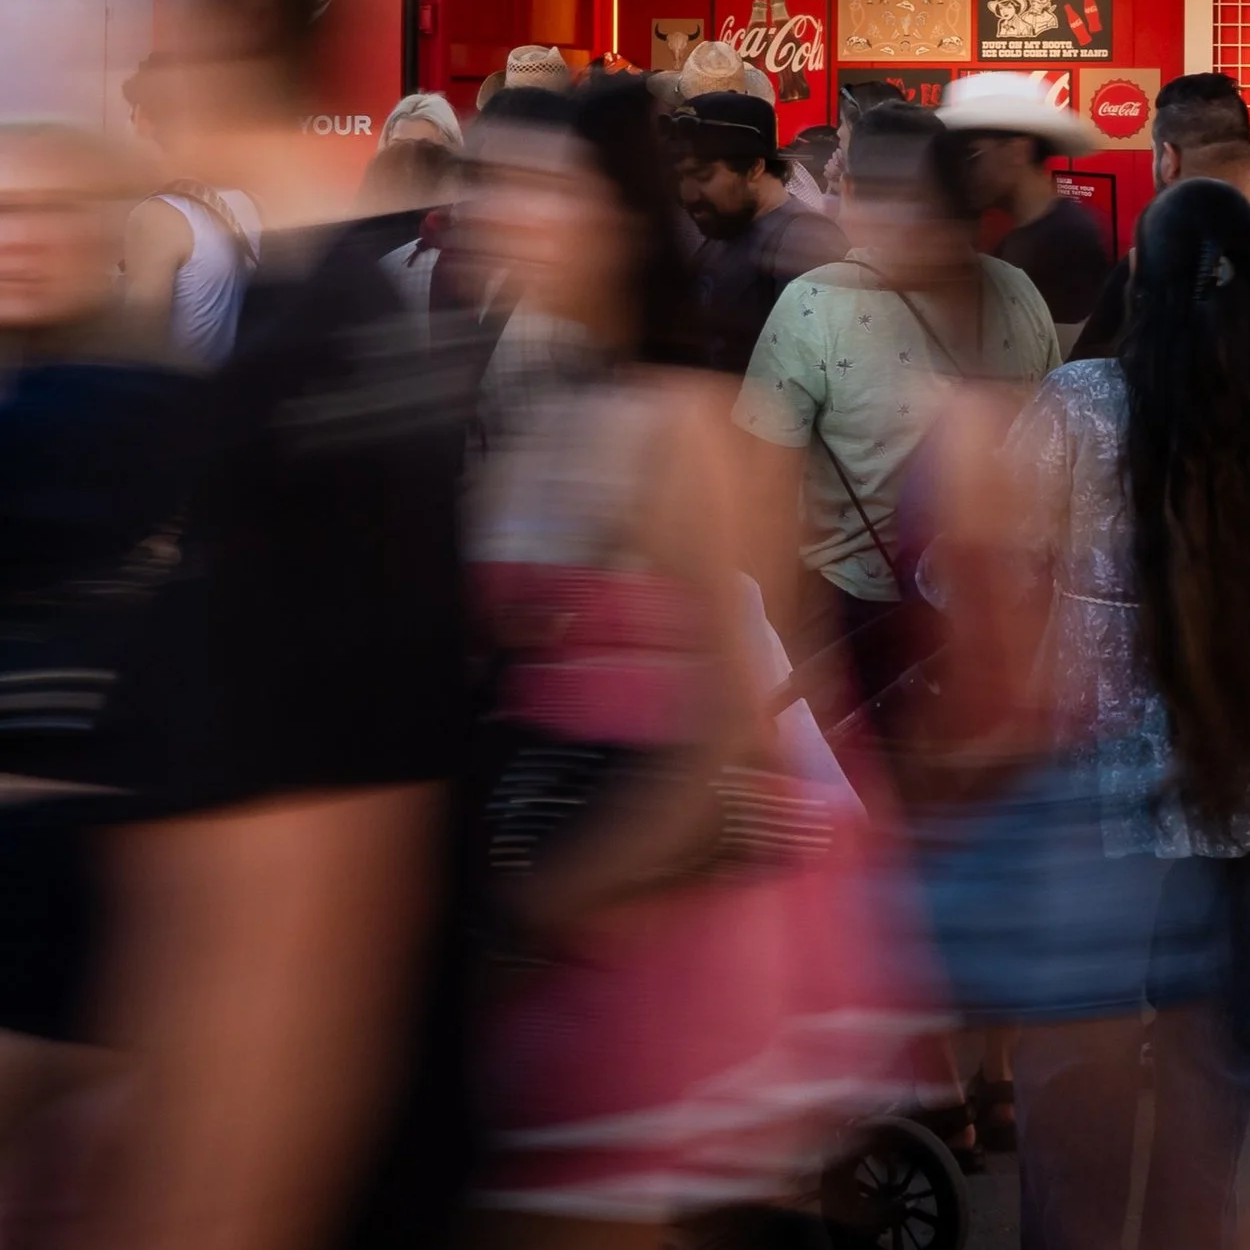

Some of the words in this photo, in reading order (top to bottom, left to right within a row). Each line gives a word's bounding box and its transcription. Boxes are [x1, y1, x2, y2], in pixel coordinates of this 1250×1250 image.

[982, 41, 1006, 49] DUST
[1008, 41, 1022, 49] ON
[1024, 41, 1041, 49] MY
[982, 49, 997, 58] ICE
[998, 49, 1022, 58] COLD
[1023, 49, 1048, 58] COKE
[1049, 49, 1061, 58] IN
[1062, 49, 1079, 58] MY
[1080, 49, 1108, 58] HAND
[299, 115, 372, 135] YOUR
